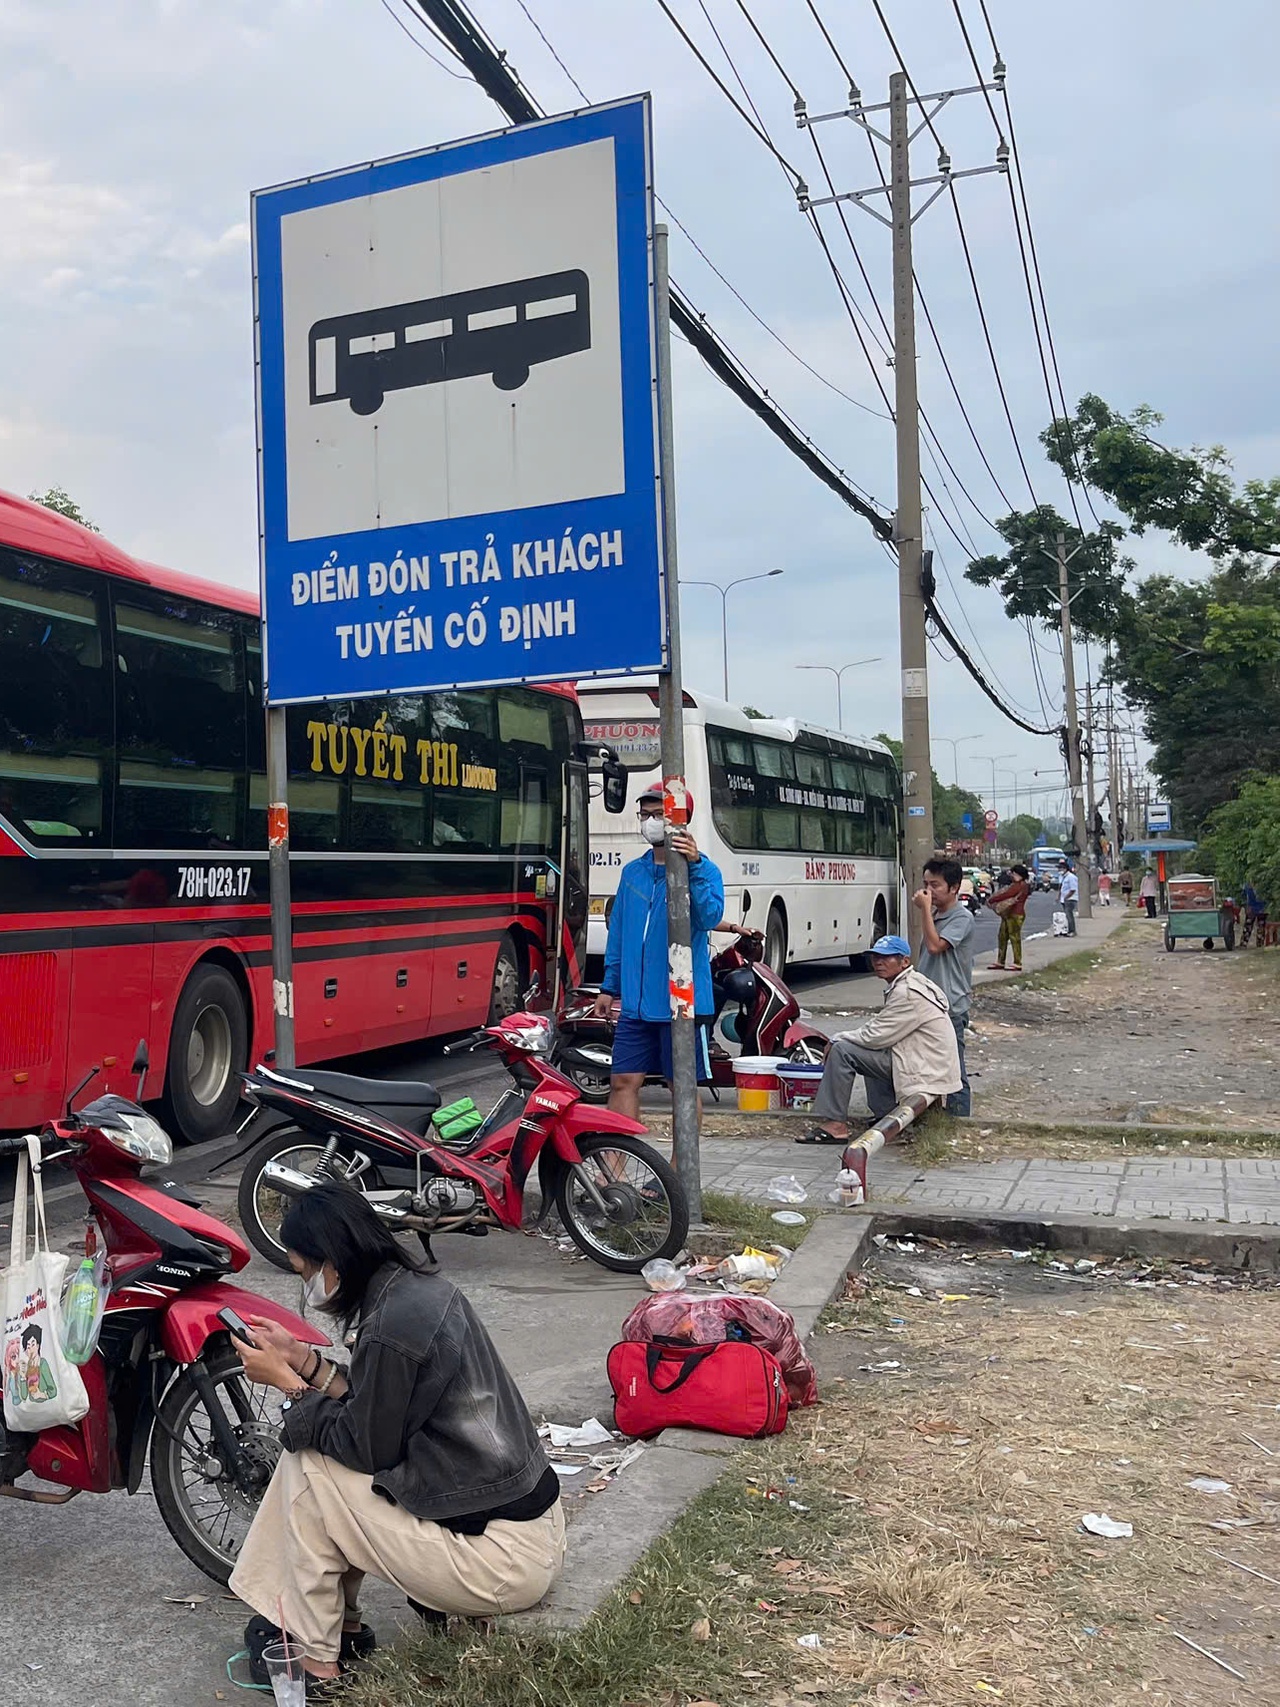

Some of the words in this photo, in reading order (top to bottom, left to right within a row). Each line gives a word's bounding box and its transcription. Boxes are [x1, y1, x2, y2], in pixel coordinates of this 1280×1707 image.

[291, 551, 359, 606] ĐIỂM
[368, 550, 430, 596] ĐÓN
[439, 533, 501, 588] TRẢ
[512, 527, 623, 579] KHÁCH
[336, 605, 433, 659] TUYẾN
[443, 596, 490, 648] CỐ
[499, 599, 576, 650] ĐỊNH
[307, 711, 406, 781] TUYẾT
[416, 739, 458, 787] THI
[177, 867, 251, 898] 78H-023.17
[156, 1264, 191, 1277] HONDA
